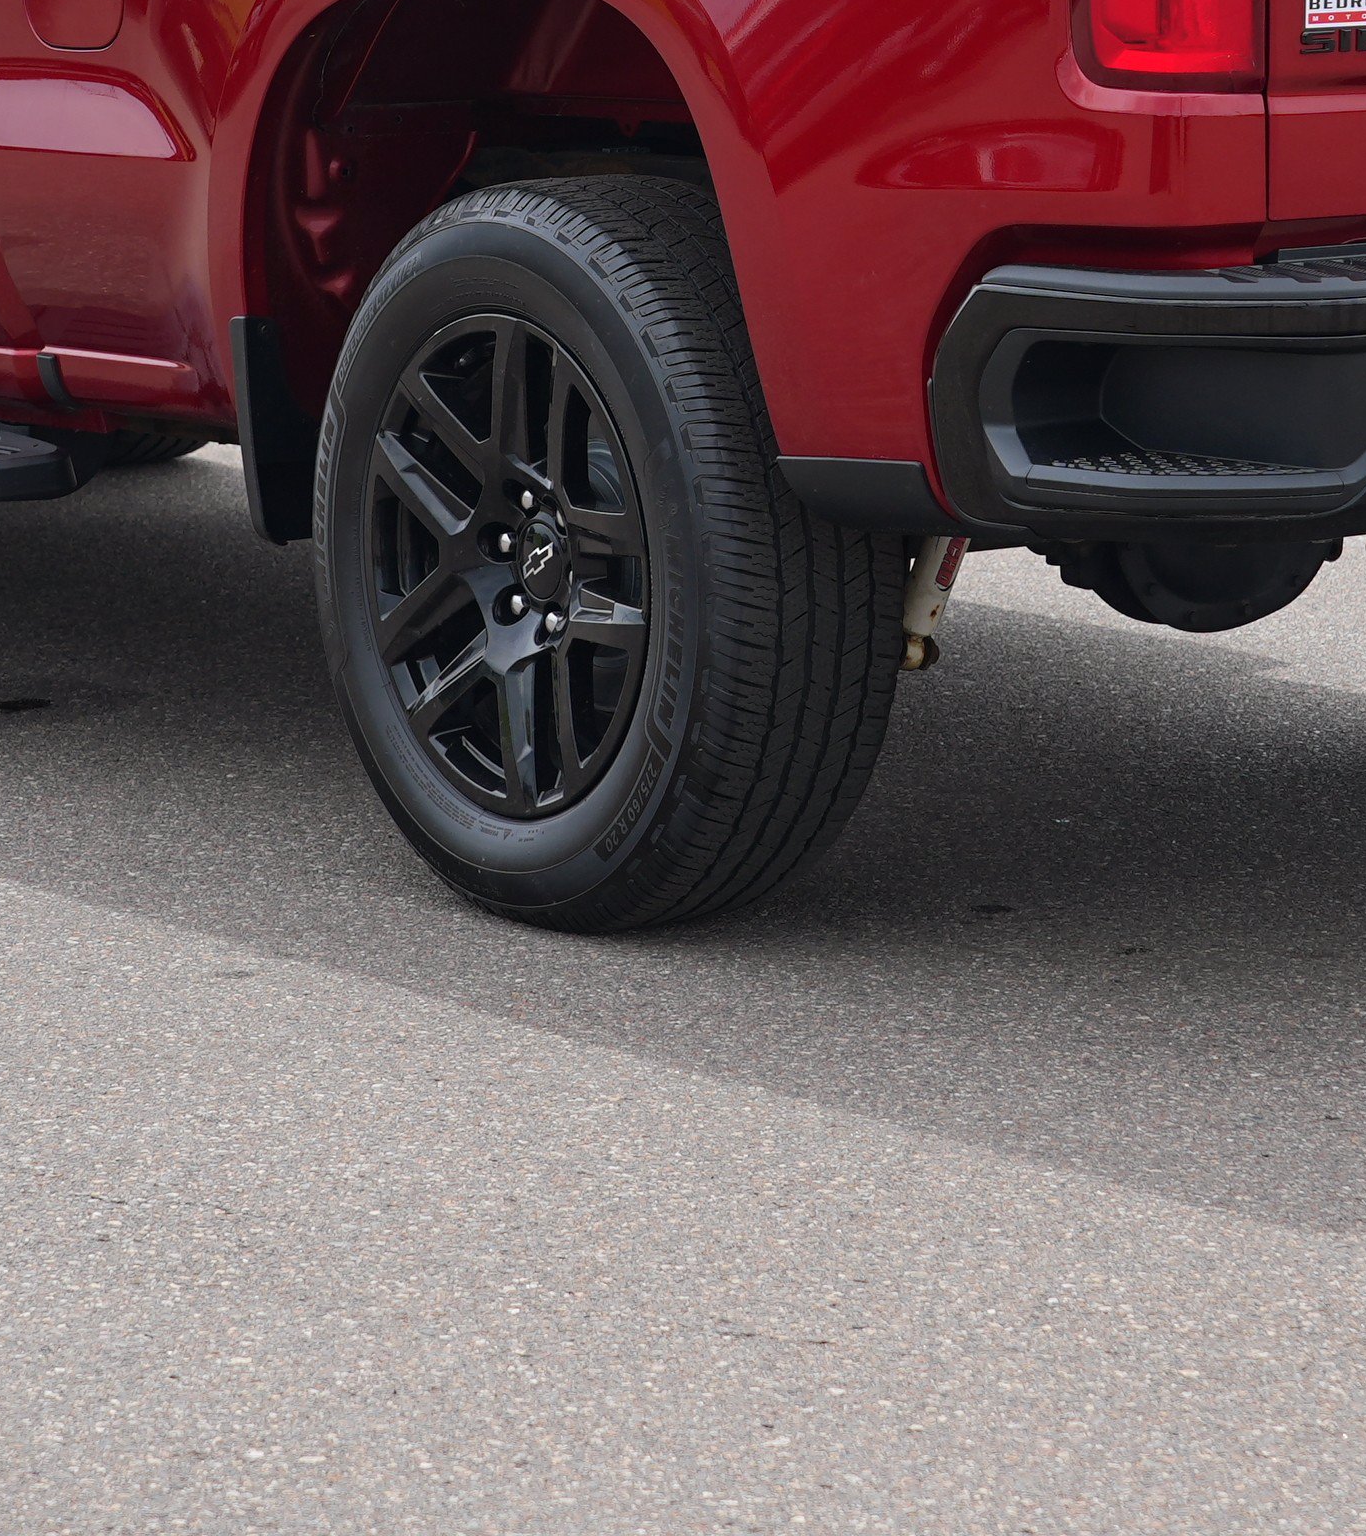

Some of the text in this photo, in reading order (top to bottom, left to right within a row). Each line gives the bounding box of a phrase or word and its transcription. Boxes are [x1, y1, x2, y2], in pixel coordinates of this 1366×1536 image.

[604, 762, 658, 853] 275/60 R 20
